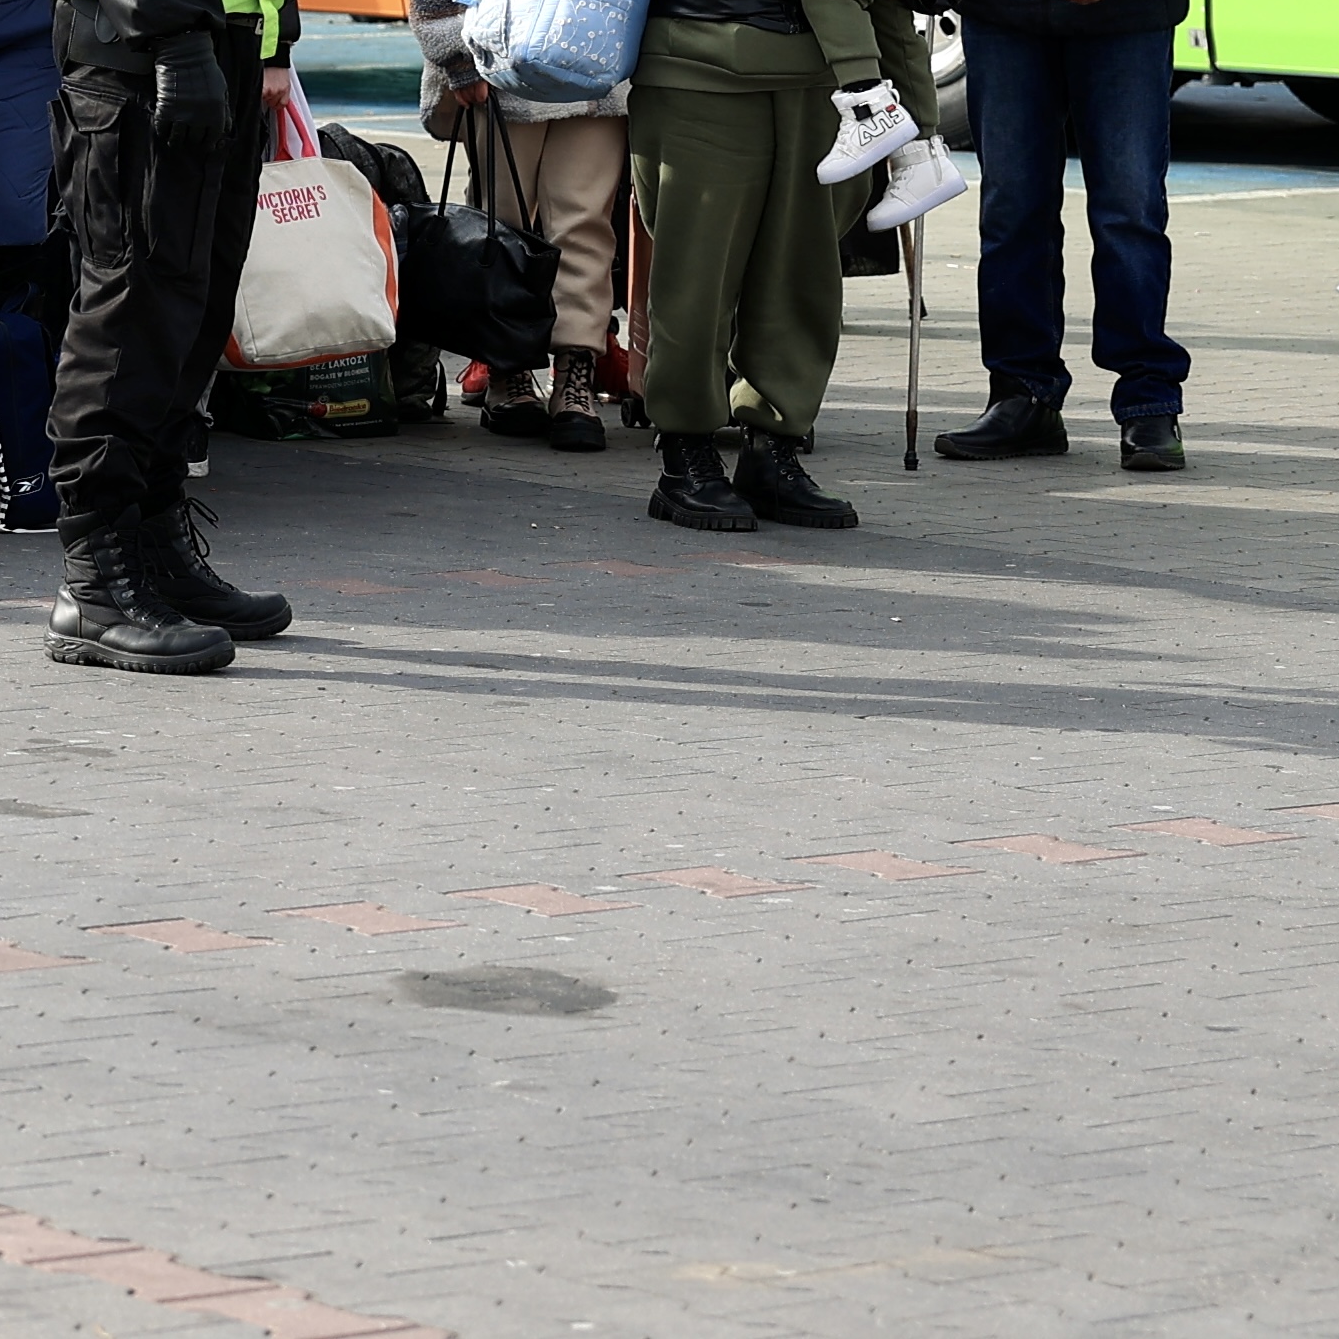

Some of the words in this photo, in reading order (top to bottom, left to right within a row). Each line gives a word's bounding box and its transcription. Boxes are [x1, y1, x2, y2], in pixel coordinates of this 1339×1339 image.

[257, 185, 327, 210] VICTORIA'S
[272, 202, 321, 224] SECRET
[329, 355, 367, 369] LAKTOZY
